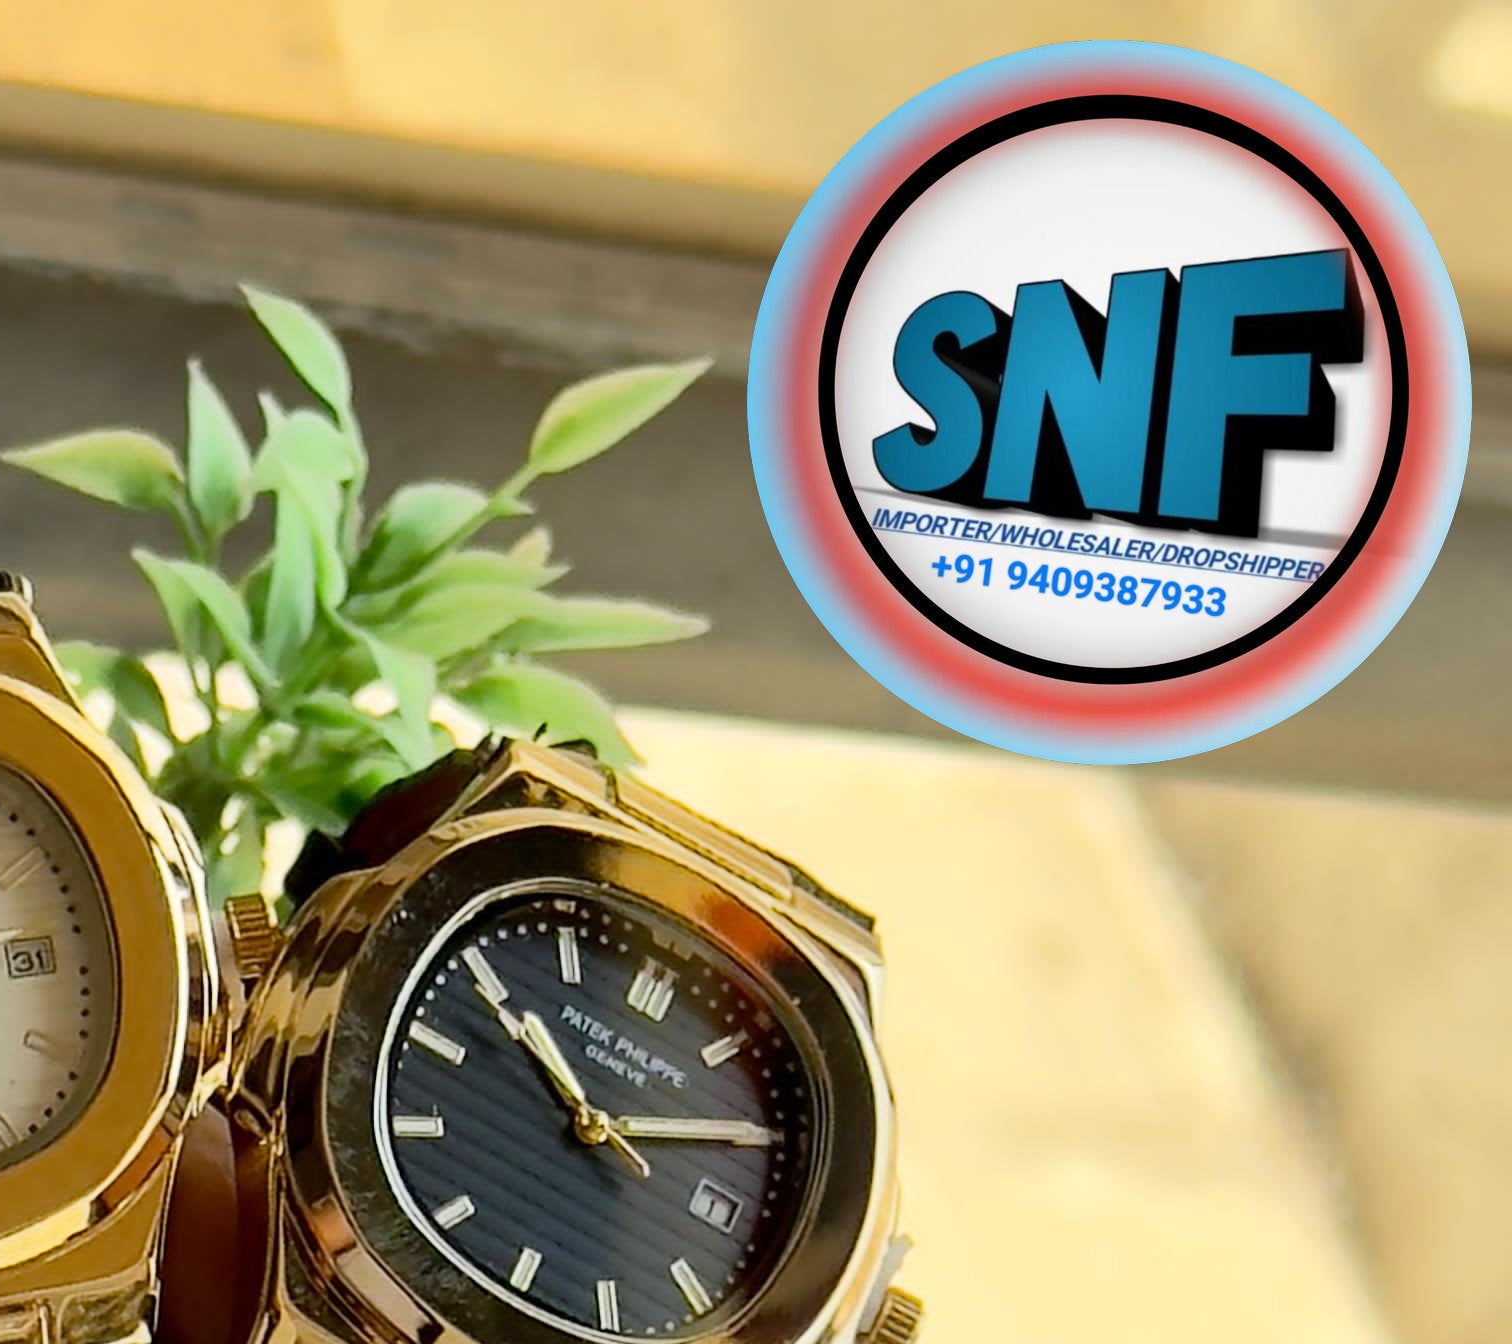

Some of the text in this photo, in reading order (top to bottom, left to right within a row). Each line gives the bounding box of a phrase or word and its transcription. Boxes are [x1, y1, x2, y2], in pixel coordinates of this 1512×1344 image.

[11, 952, 46, 973] 31
[560, 1004, 687, 1089] PATEK PHILIPPE
[585, 1044, 648, 1088] GENEVE
